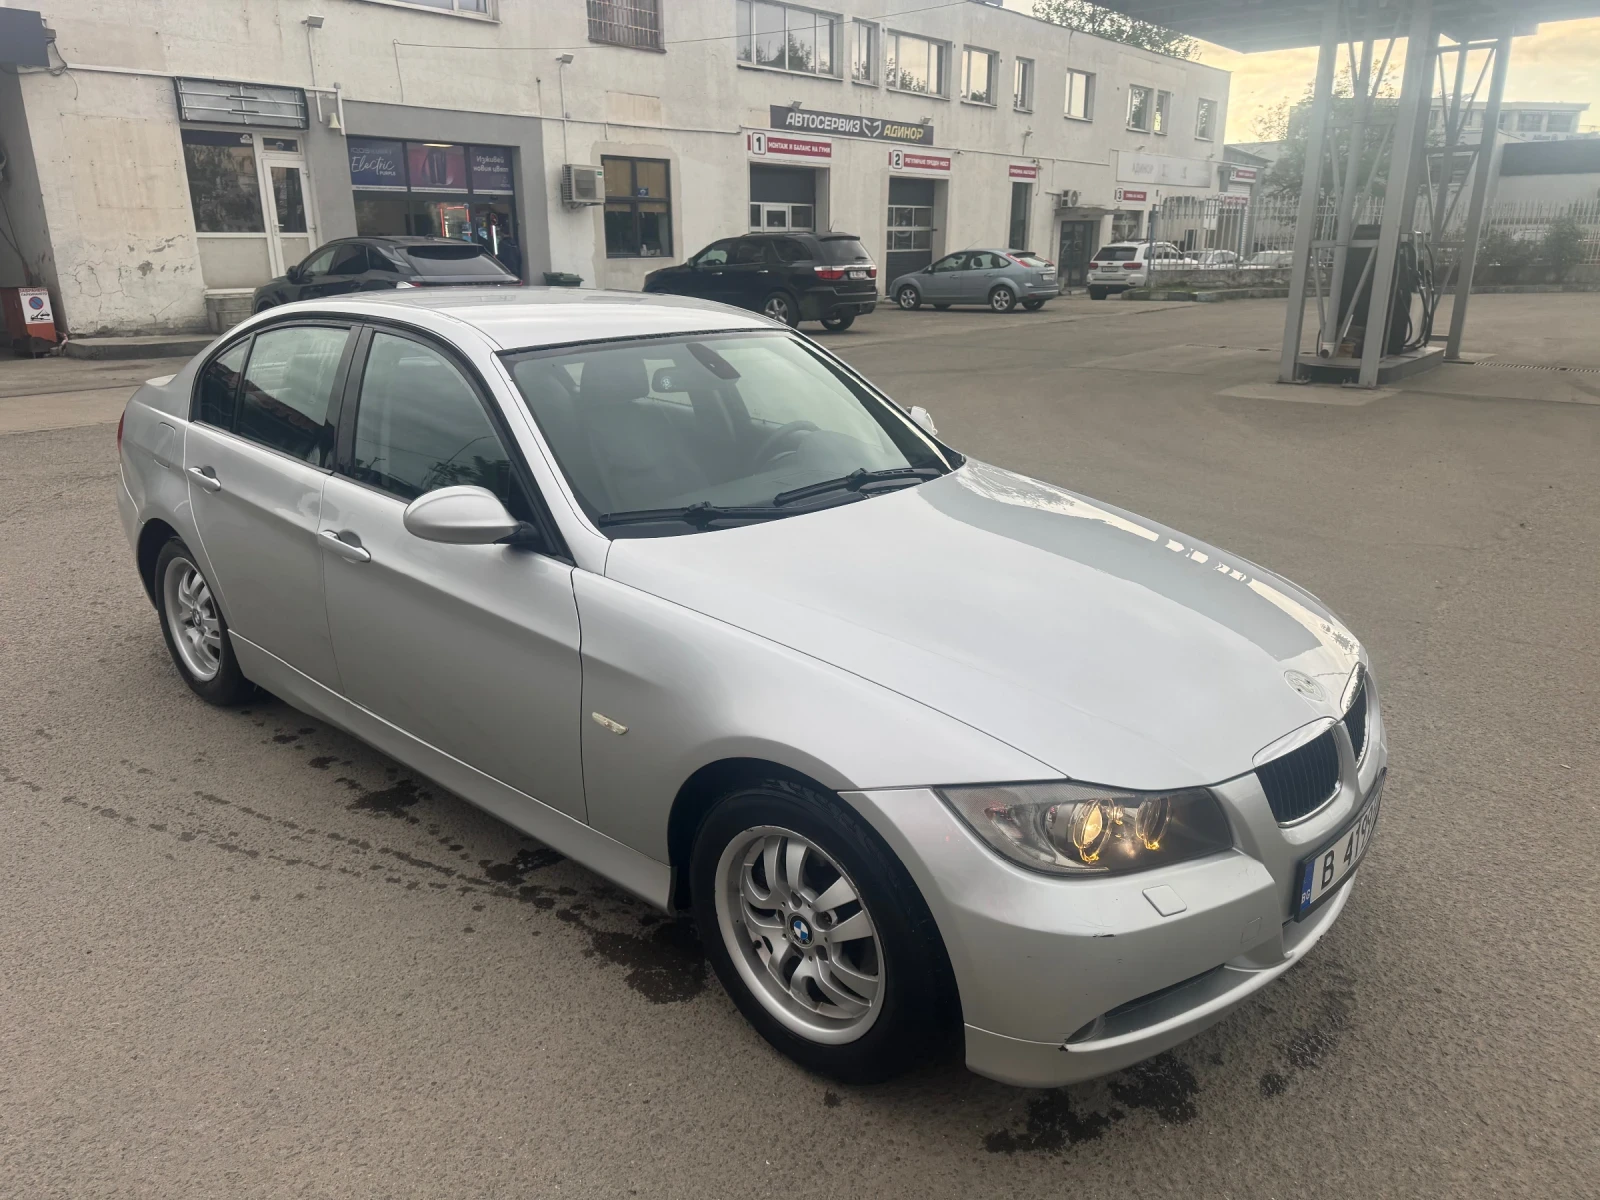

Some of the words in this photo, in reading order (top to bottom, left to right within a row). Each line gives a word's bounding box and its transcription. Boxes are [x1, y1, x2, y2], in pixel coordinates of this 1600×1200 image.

[786, 112, 860, 133] АВТОСЕРВИЗ
[883, 124, 924, 141] АДИНОР
[756, 136, 762, 151] 1
[768, 141, 788, 150] МОНТАЖ
[793, 143, 811, 152] БАЛАНС
[351, 155, 395, 176] Electric
[476, 155, 505, 165] Изживей
[895, 153, 901, 166] 2
[473, 164, 492, 172] новия
[1320, 849, 1335, 891] B
[1300, 888, 1311, 905] BG
